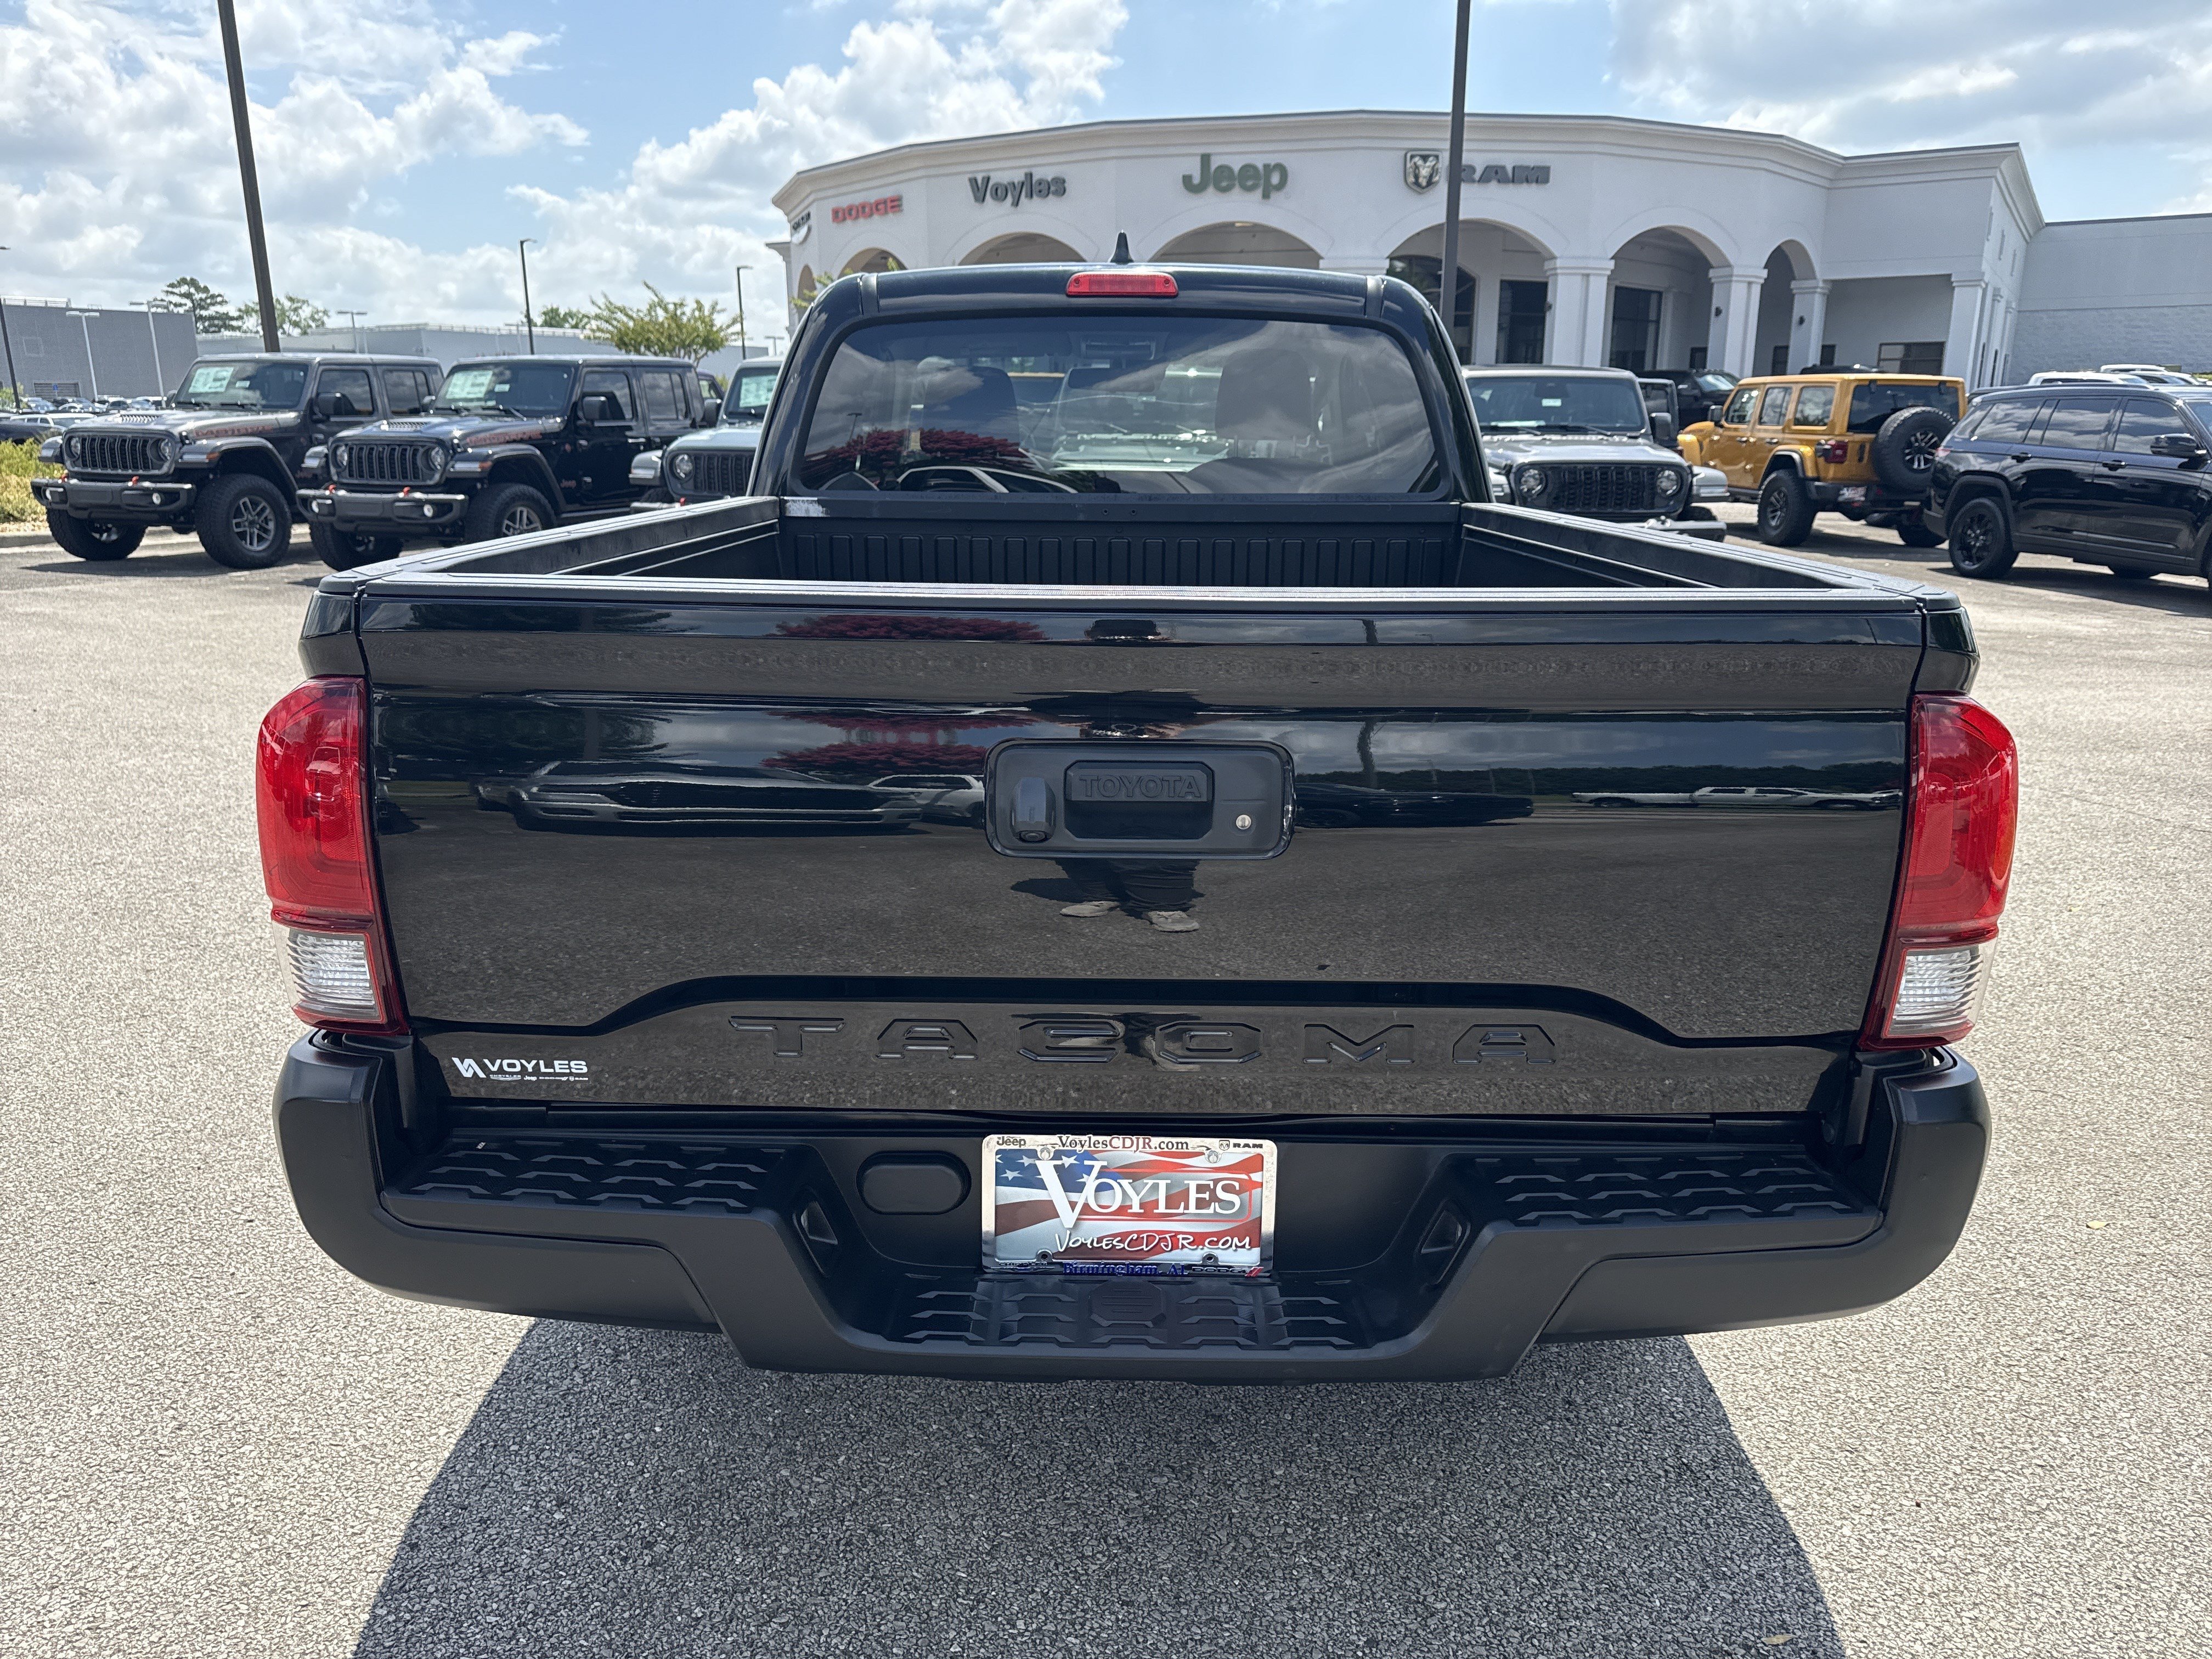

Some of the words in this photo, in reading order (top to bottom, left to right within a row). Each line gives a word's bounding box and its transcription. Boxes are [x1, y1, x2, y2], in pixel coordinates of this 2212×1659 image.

[968, 171, 1066, 207] Voyles
[1182, 153, 1288, 199] Jeep
[831, 194, 903, 223] DODGE
[1079, 774, 1202, 798] TOYOTA
[729, 1015, 1555, 1063] TACOMA
[483, 1059, 588, 1073] VOYLES
[996, 1136, 1026, 1148] Jeep
[1057, 1135, 1189, 1152] VoylesCDJR.com
[1035, 1160, 1242, 1228] VOYLES
